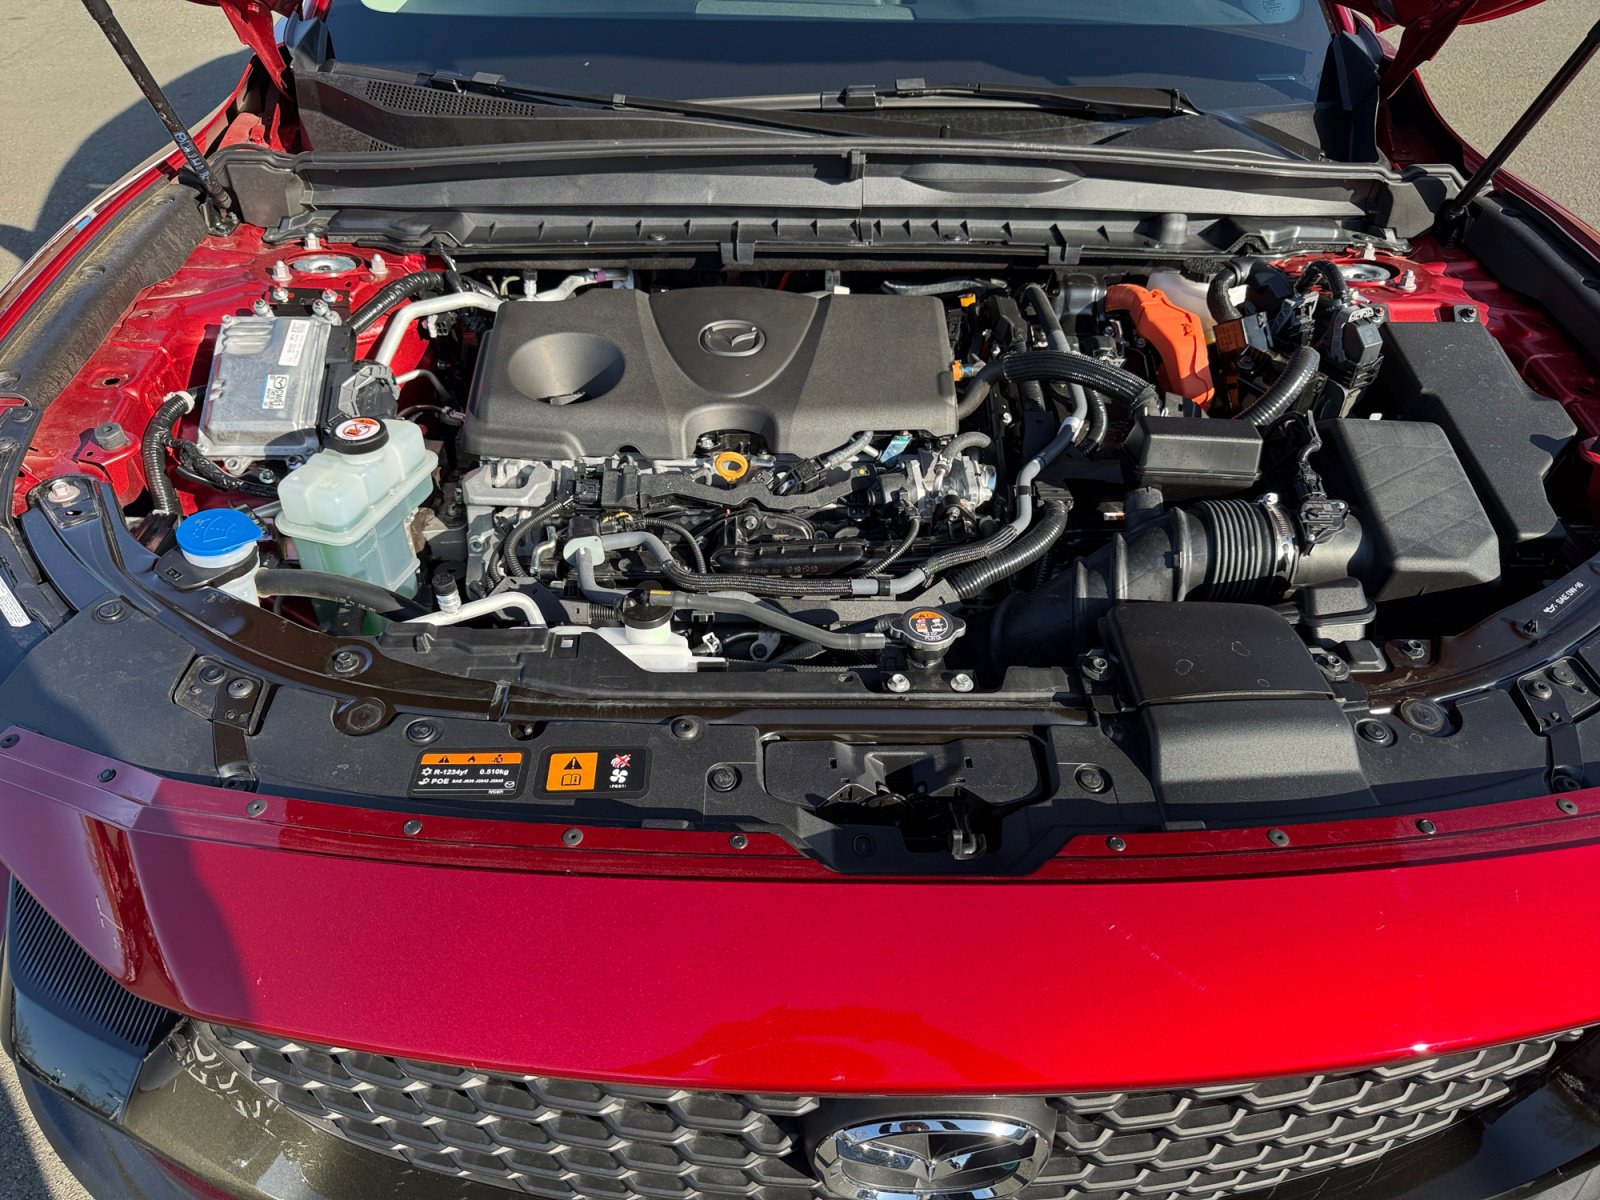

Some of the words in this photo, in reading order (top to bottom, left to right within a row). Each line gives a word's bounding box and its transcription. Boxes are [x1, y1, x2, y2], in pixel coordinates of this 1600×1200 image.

[1555, 593, 1570, 605] SAE
[433, 768, 469, 776] R-1234yf
[479, 768, 509, 776] 0.510kg
